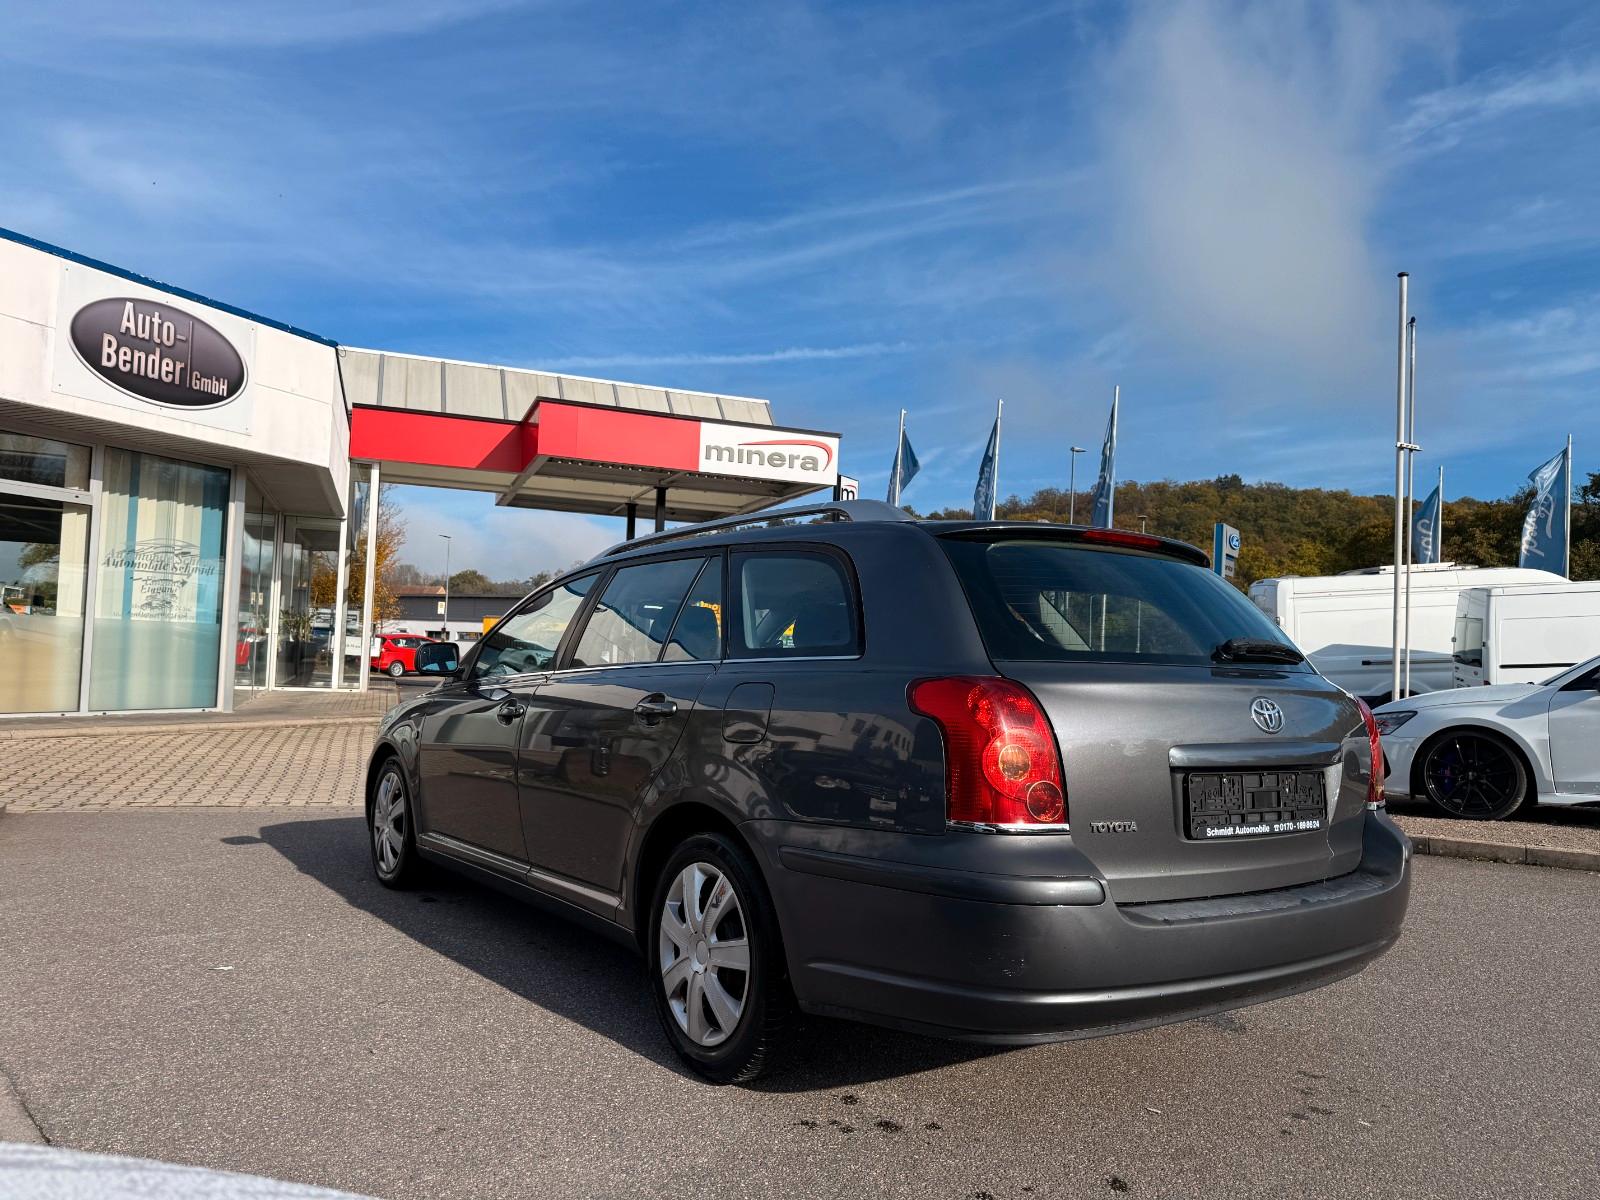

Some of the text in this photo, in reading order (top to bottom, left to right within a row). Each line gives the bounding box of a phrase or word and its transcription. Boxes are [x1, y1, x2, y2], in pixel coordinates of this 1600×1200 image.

[120, 301, 187, 347] Auto-
[101, 332, 229, 397] Bender GmbH
[705, 444, 820, 472] minera
[102, 557, 170, 571] Automobile
[1090, 821, 1137, 833] TOYOTA
[1206, 827, 1234, 837] Schmidt
[1235, 824, 1270, 835] Automobile
